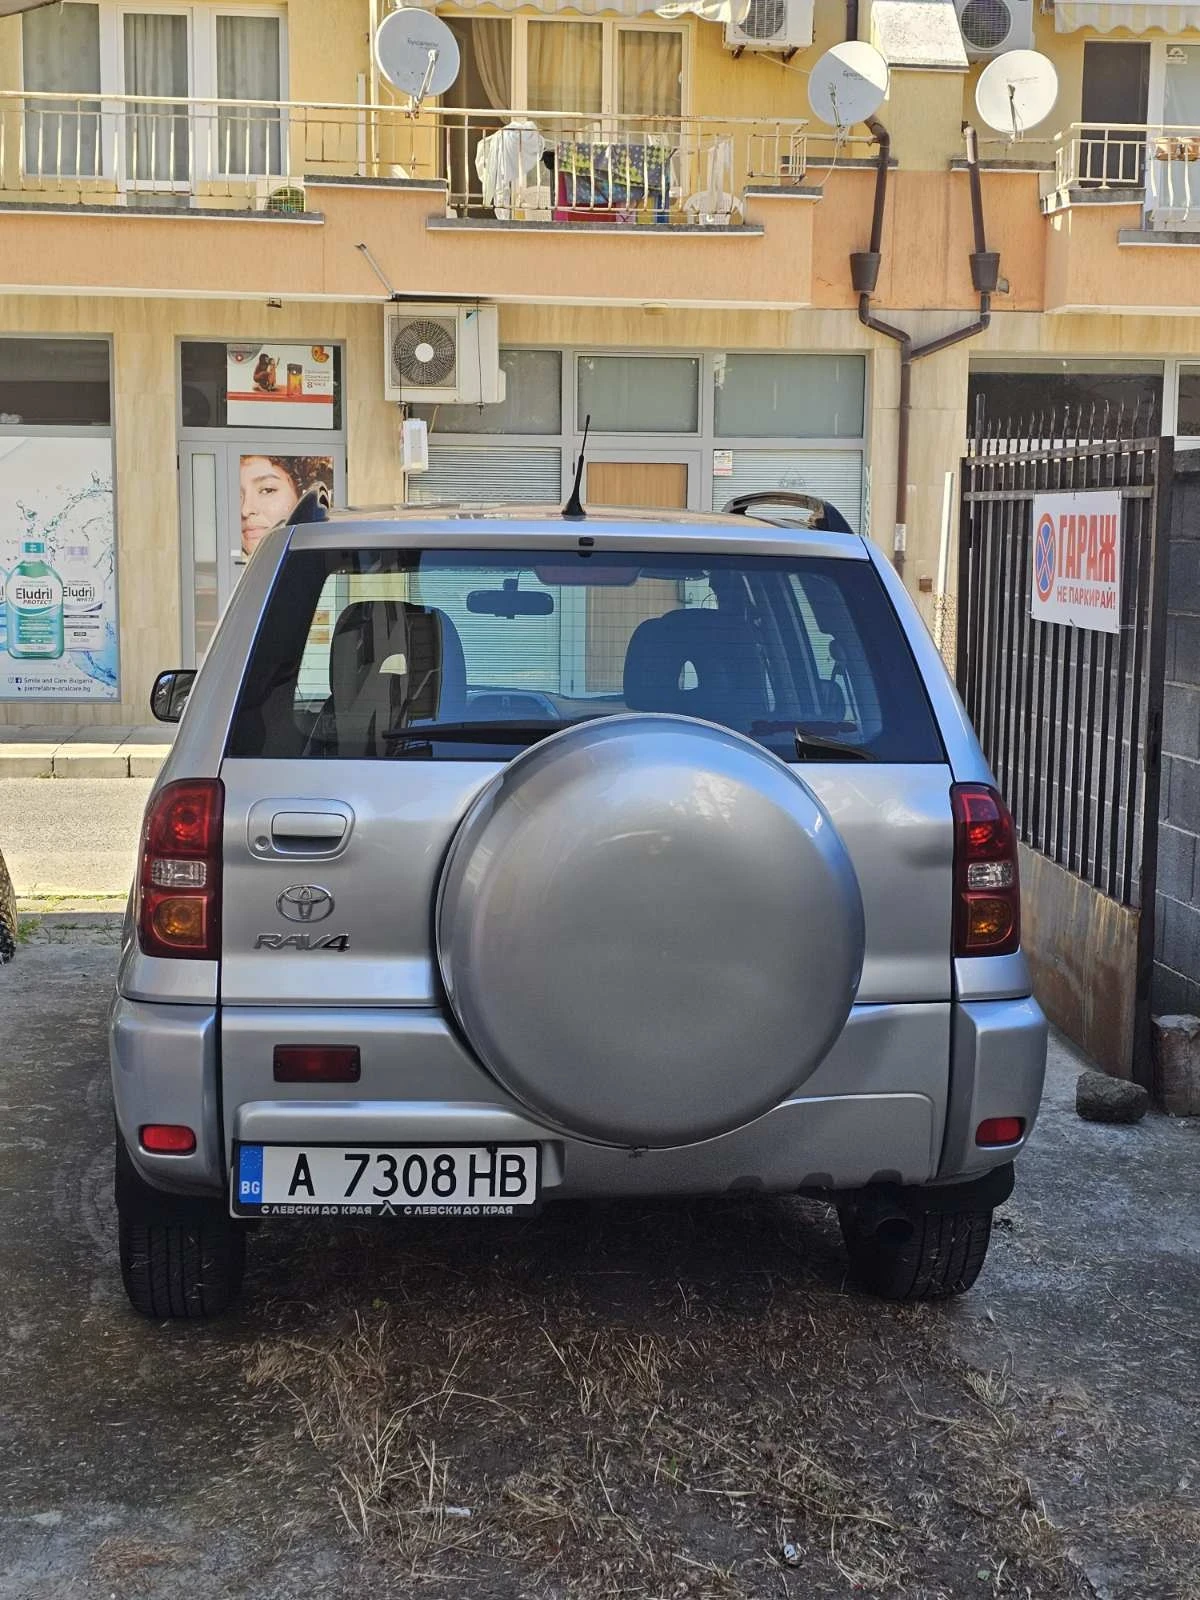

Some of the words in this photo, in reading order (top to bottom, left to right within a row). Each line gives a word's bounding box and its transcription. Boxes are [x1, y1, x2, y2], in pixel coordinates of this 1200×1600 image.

[1058, 514, 1117, 582] ГАРАЖ
[16, 587, 53, 599] Eludril
[63, 586, 95, 597] Eludril
[1057, 586, 1066, 603] НЕ
[1068, 587, 1116, 610] ПАРКИРАЙ!
[253, 933, 350, 952] RAV4
[287, 1153, 315, 1197] A
[344, 1153, 457, 1198] 7308
[241, 1181, 260, 1195] BG
[272, 1205, 320, 1215] ЛЕВСКИ
[321, 1206, 339, 1215] ДО
[341, 1206, 372, 1215] КРАЯ
[414, 1206, 462, 1215] ЛЕВСКИ
[463, 1206, 480, 1215] ДО
[482, 1205, 513, 1215] КРАЯ
